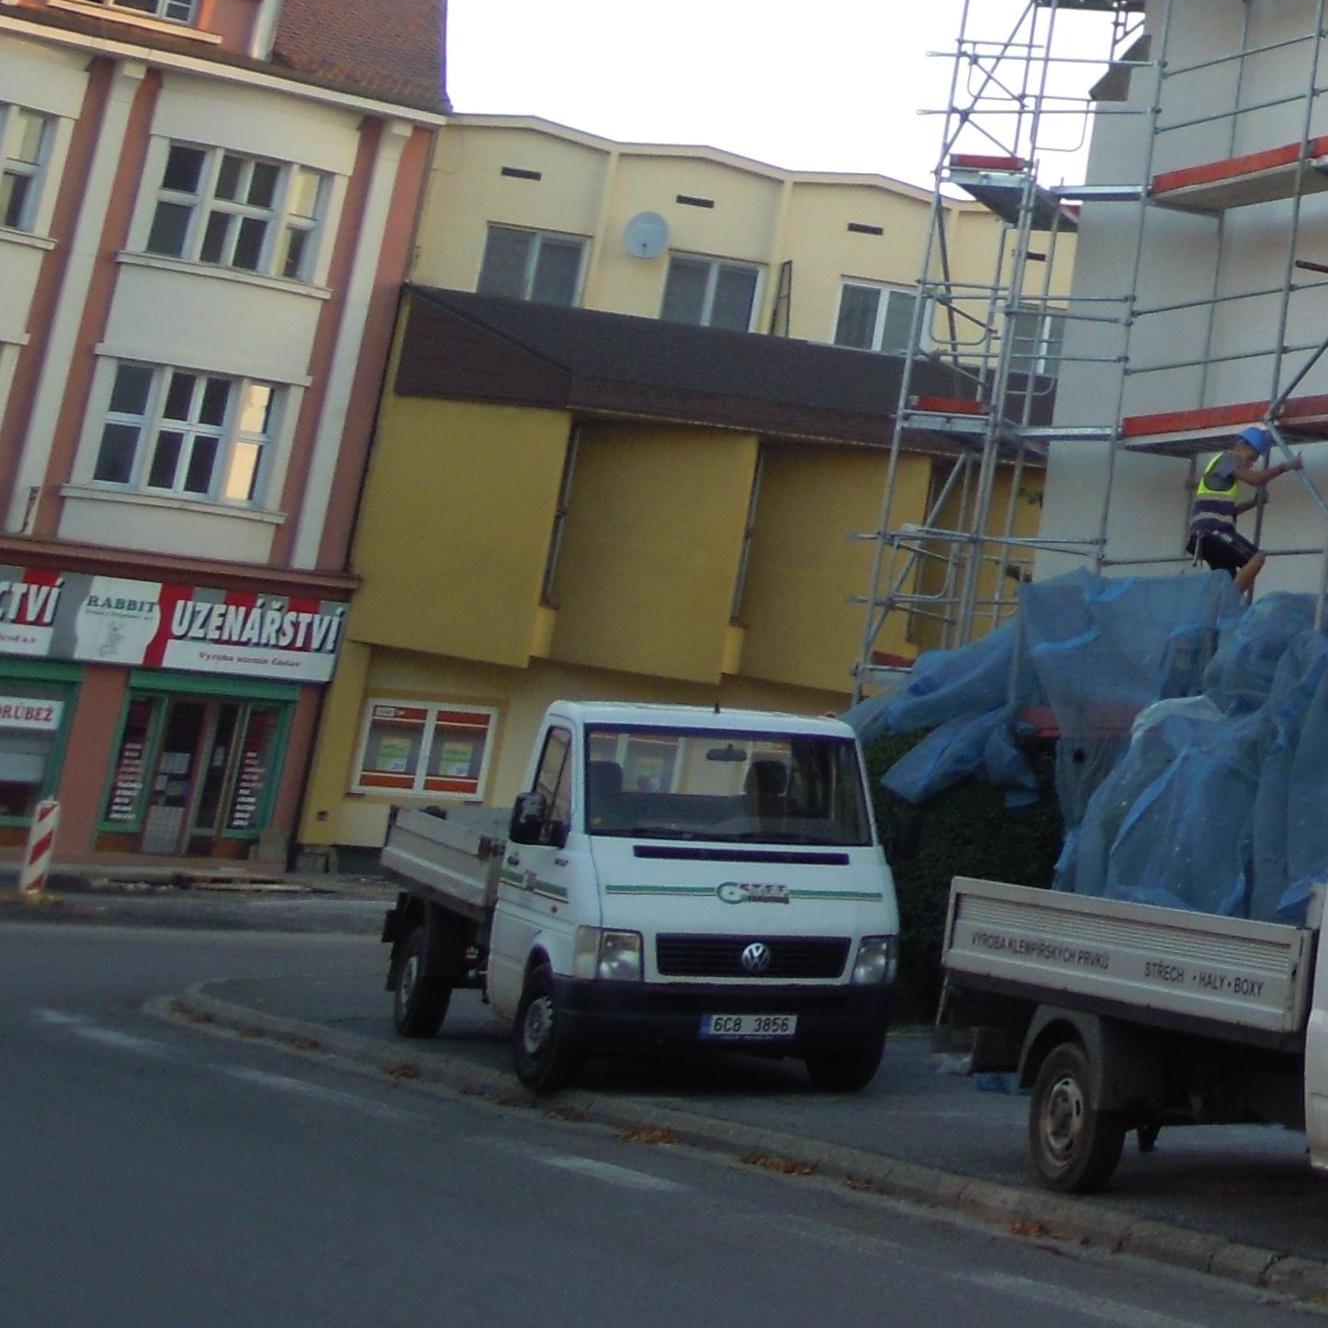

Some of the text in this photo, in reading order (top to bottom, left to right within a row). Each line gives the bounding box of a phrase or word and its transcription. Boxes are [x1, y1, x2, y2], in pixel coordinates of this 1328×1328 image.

[87, 595, 158, 613] RABBIT
[171, 597, 344, 651] UZENÁŘSTVÍ
[1144, 959, 1264, 997] STŘECH HALY BOXY
[753, 1017, 790, 1033] 3856
